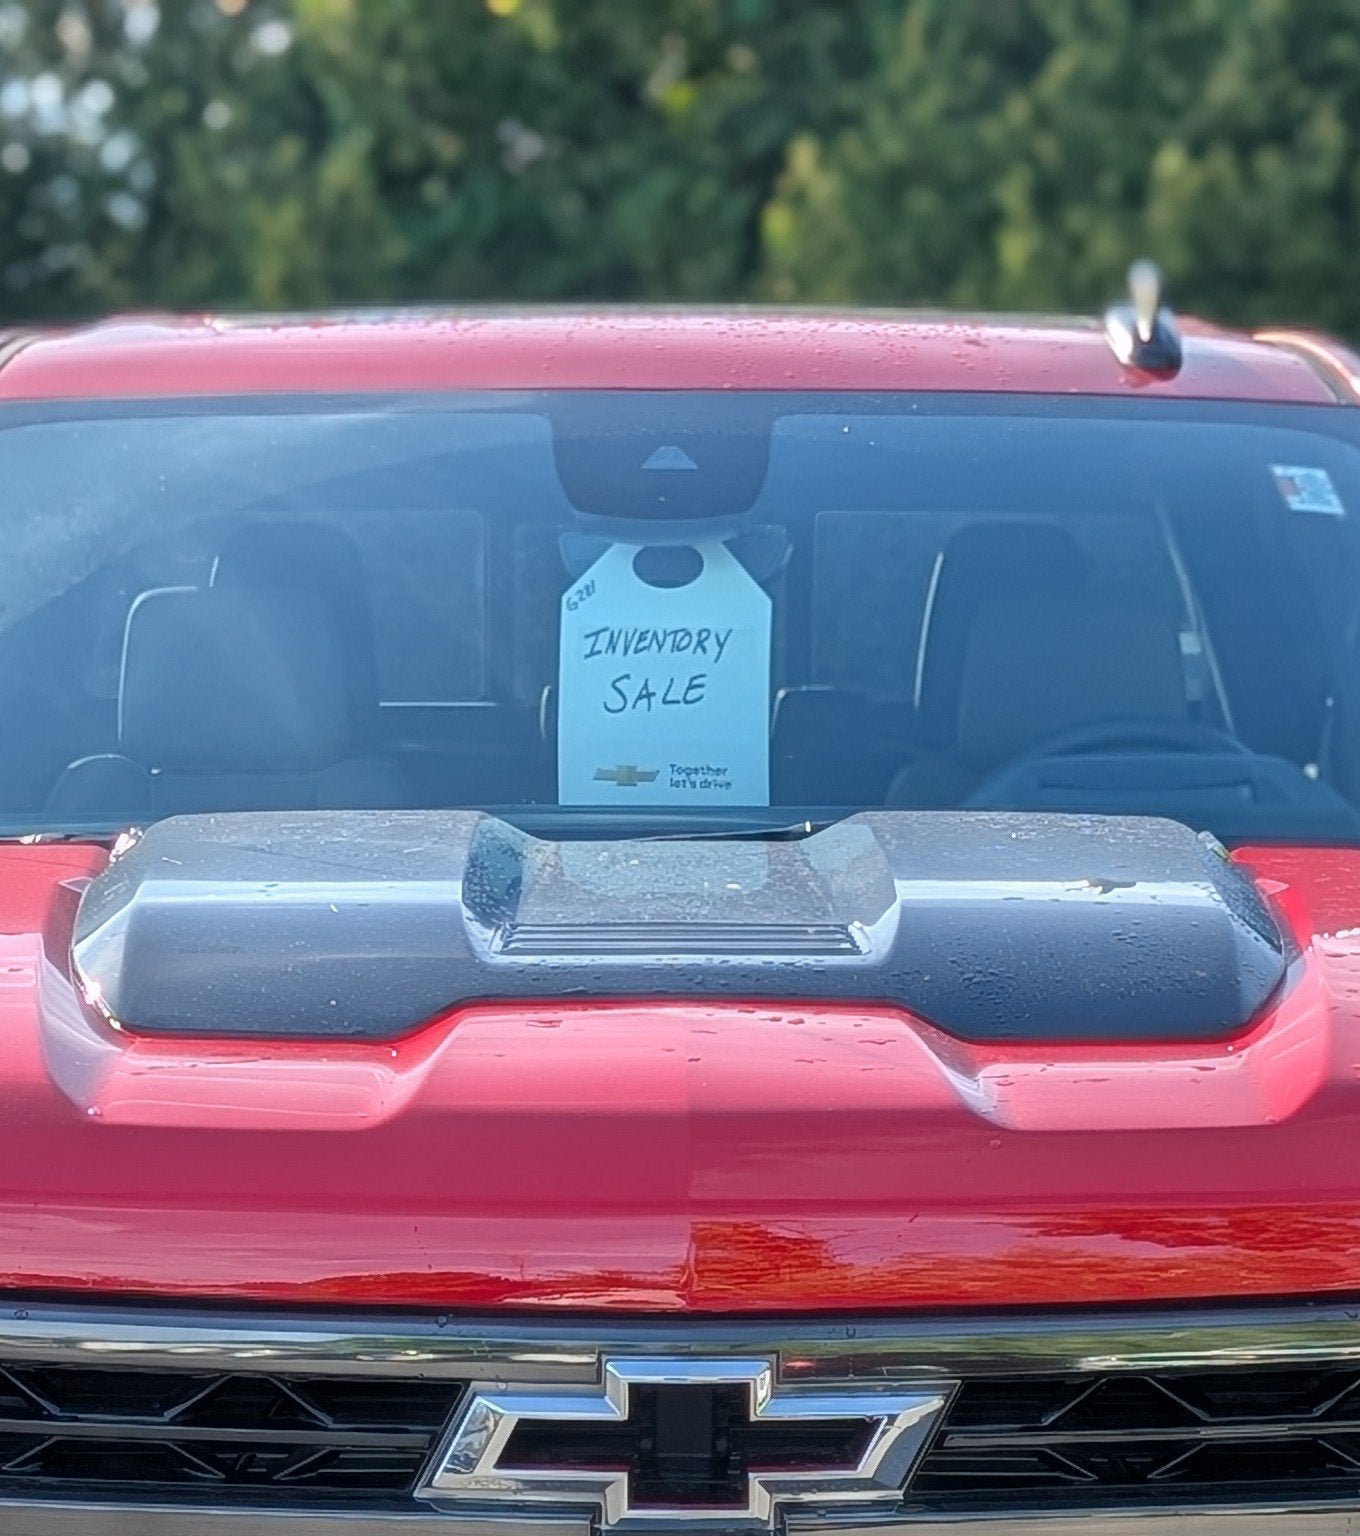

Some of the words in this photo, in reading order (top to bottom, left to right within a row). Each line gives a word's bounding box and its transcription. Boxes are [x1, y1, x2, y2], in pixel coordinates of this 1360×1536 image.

[583, 627, 732, 663] INVENTORY
[603, 674, 707, 714] SALE
[669, 763, 728, 780] Together
